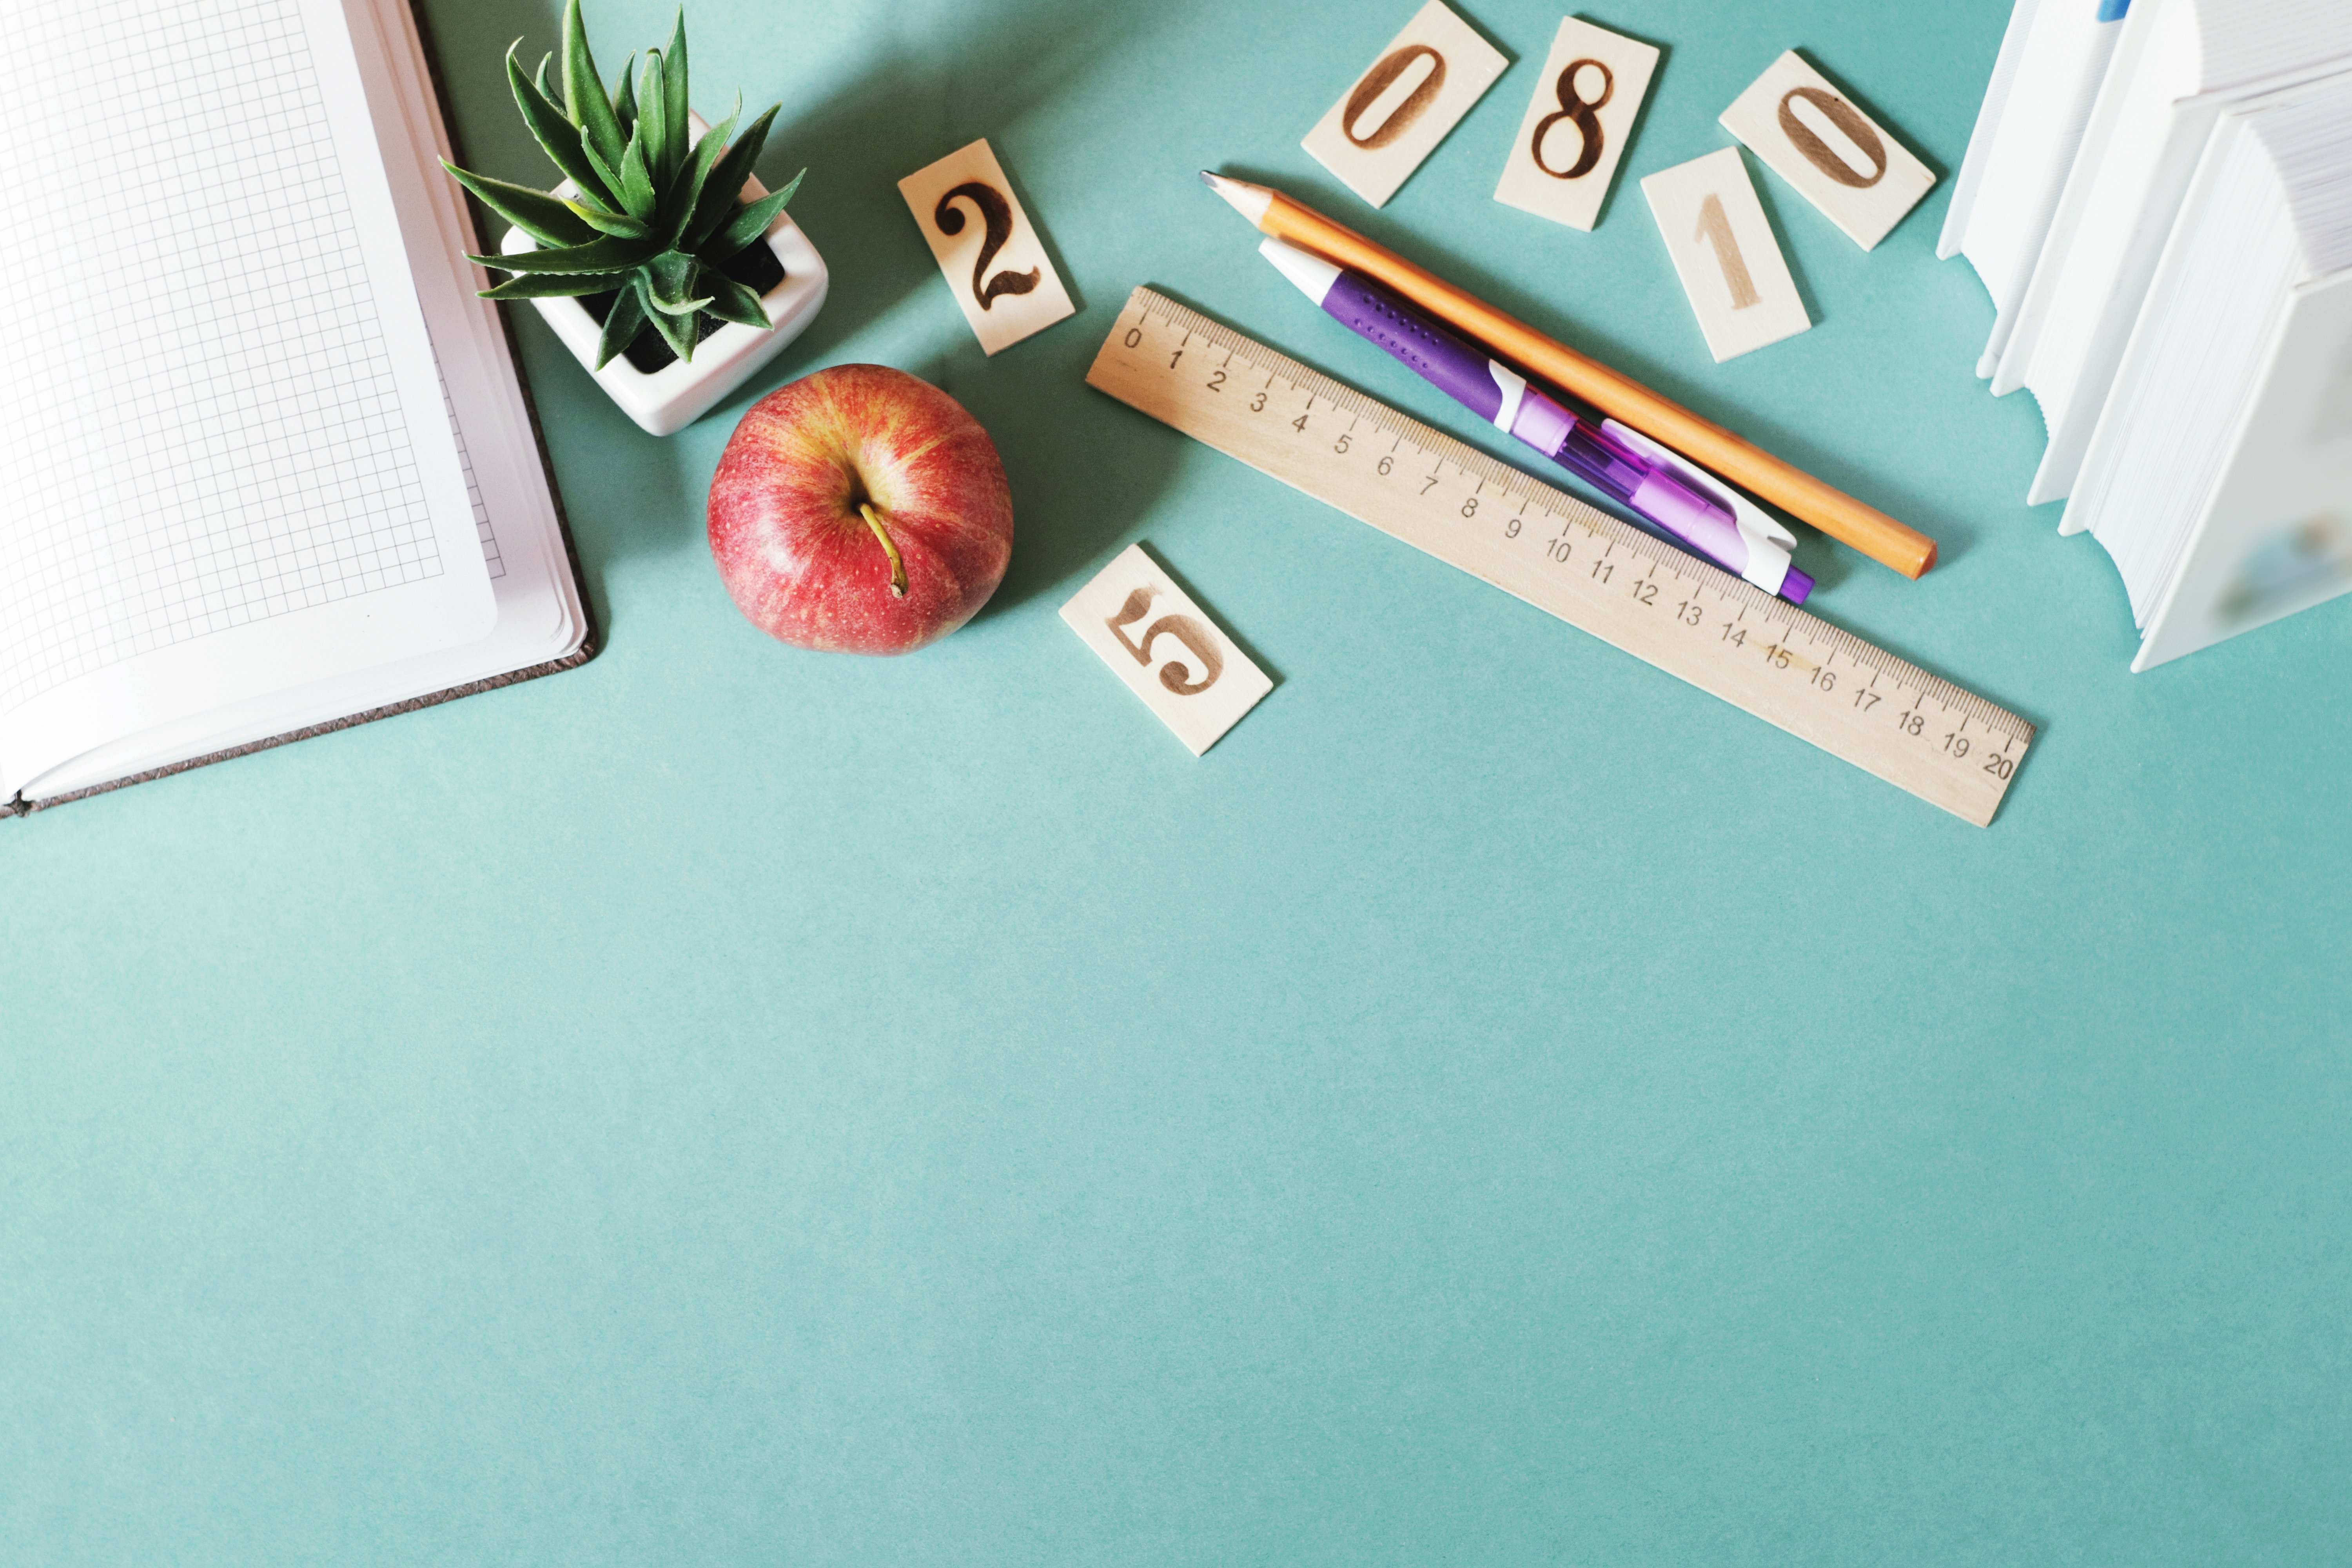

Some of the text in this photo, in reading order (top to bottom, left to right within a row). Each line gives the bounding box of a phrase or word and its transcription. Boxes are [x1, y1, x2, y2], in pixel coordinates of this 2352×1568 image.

[1343, 44, 1447, 151] 0
[1531, 58, 1615, 180] 8
[1777, 86, 1888, 189] 0
[935, 181, 1041, 311] 2
[1693, 193, 1762, 310] 1
[1124, 328, 2014, 780] 0 1 2 3 4 5 6 7 8 9 10 11 12 13 14 15 16 17 18 19 20
[1105, 584, 1225, 696] 5
